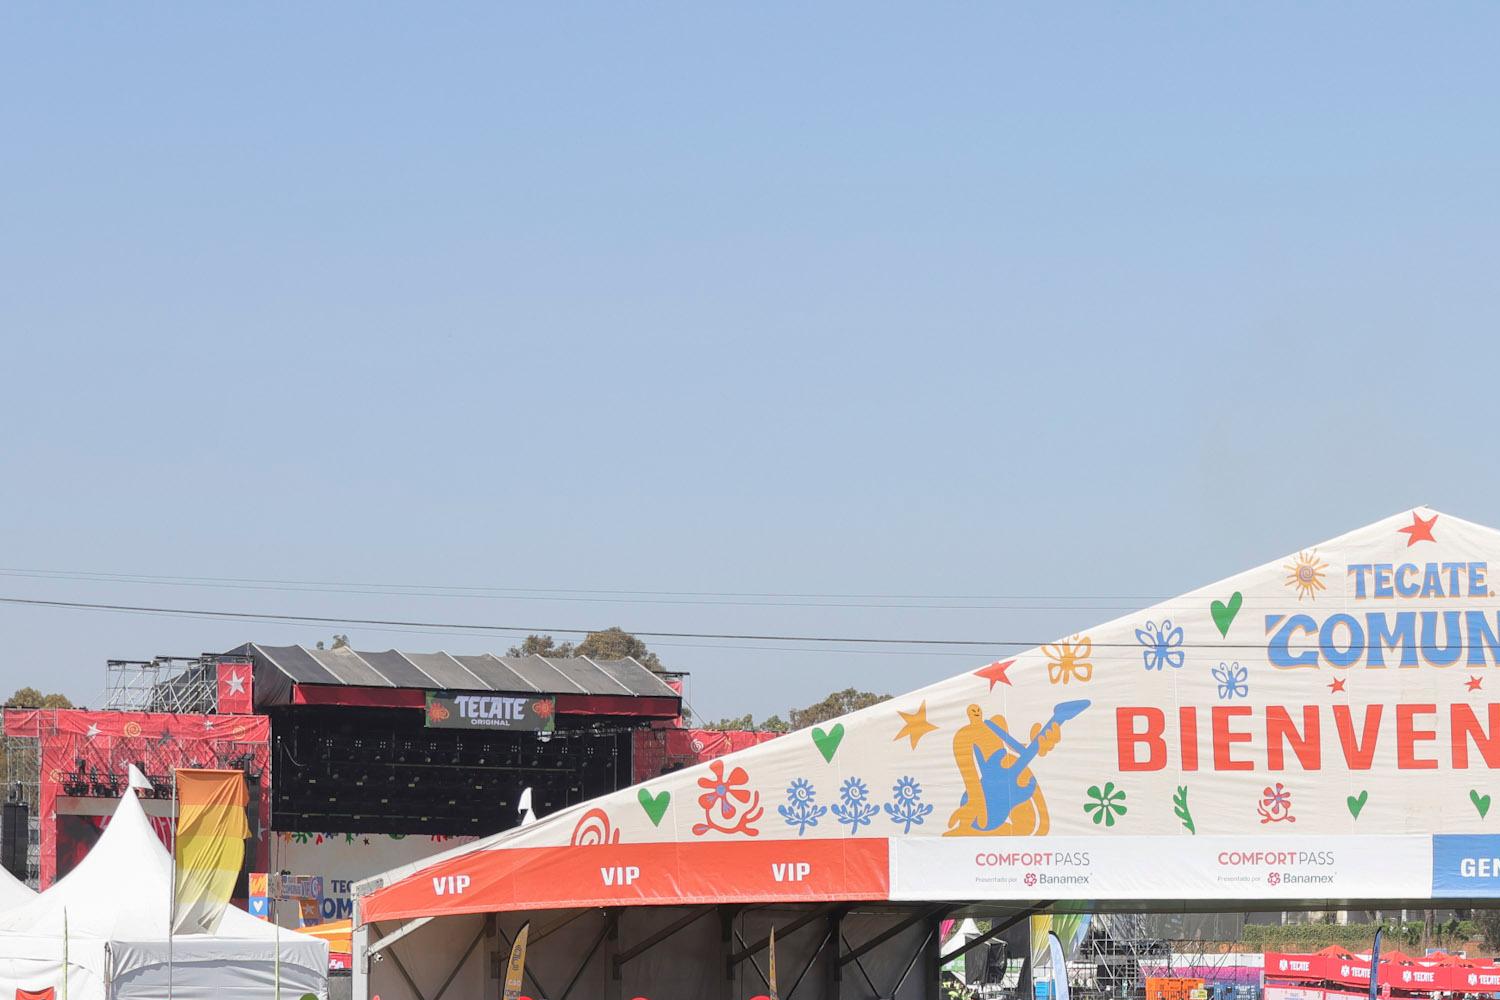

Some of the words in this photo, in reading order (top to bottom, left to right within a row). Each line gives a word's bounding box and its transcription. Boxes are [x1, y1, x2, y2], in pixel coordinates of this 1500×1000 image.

[1347, 562, 1488, 598] TECATE
[454, 696, 529, 720] TECATE
[432, 875, 471, 896] VIP
[600, 866, 640, 886] VIP
[771, 863, 811, 882] VIP
[1040, 874, 1089, 884] Banamex
[1283, 873, 1334, 883] Banamex
